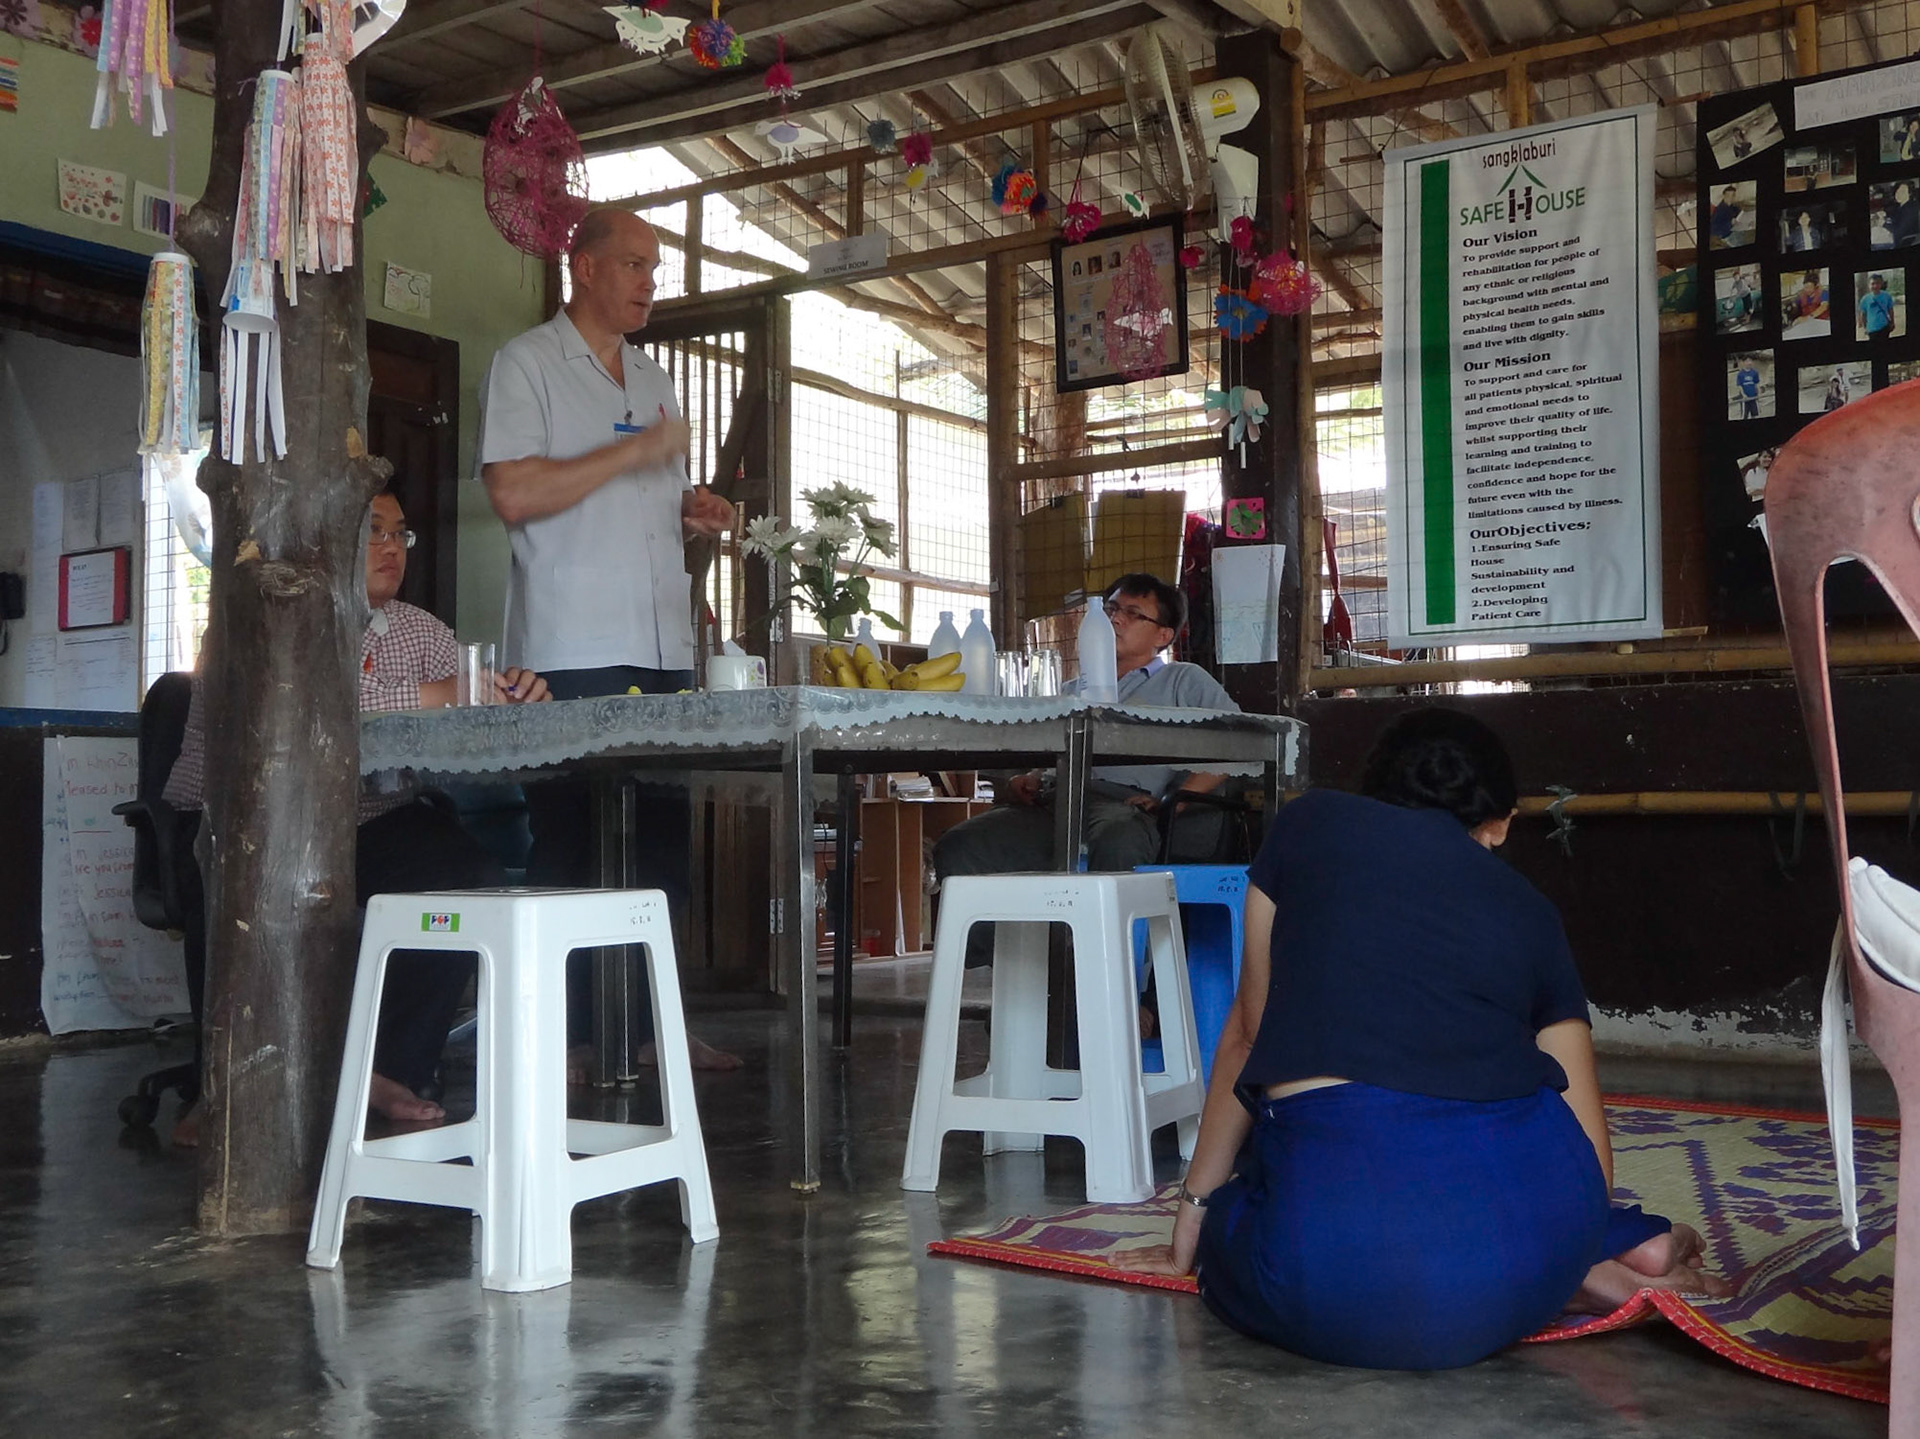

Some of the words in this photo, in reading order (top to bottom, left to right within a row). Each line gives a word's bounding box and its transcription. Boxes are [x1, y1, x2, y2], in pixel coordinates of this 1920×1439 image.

[1483, 138, 1556, 169] sangklaburi
[1460, 201, 1504, 225] SAFE
[1463, 237, 1489, 248] Our
[1494, 228, 1538, 243] Vision
[1479, 249, 1516, 262] provide
[1519, 241, 1559, 255] support
[1563, 236, 1580, 246] and
[847, 260, 869, 271] ROOM
[1463, 261, 1531, 277] rehabilitation
[1535, 257, 1549, 267] for
[1552, 250, 1585, 265] people
[1463, 284, 1480, 293] any
[1484, 279, 1515, 289] ethnic
[1532, 268, 1575, 282] religious
[1463, 290, 1524, 307] background
[1527, 287, 1548, 297] with
[1552, 282, 1586, 293] mental
[1590, 277, 1609, 286] and
[1463, 308, 1504, 322] physical
[1508, 303, 1539, 315] health
[1463, 323, 1506, 336] enabling
[1510, 320, 1535, 330] them
[1552, 313, 1574, 324] gain
[1577, 308, 1604, 319] skills
[1463, 342, 1481, 350] and
[1485, 338, 1502, 347] live
[1506, 335, 1526, 345] with
[1530, 330, 1569, 344] dignity.
[1464, 361, 1490, 372] Our
[1495, 351, 1550, 368] Mission
[1479, 373, 1520, 386] support
[1523, 370, 1543, 378] and
[1546, 367, 1569, 375] care
[1572, 363, 1587, 371] for
[1480, 386, 1522, 400] patients
[1576, 374, 1622, 387] spiritual
[1465, 407, 1483, 415] and
[1486, 400, 1539, 413] emotional
[1542, 395, 1574, 406] needs
[1466, 418, 1506, 431] improve
[1510, 415, 1534, 425] their
[1538, 410, 1575, 423] quality
[1579, 408, 1590, 416] of
[1466, 435, 1495, 445] whilst
[1499, 428, 1557, 443] supporting
[1561, 424, 1587, 434] their
[1466, 449, 1507, 460] learning
[1511, 445, 1530, 454] and
[1534, 441, 1577, 452] training
[1581, 439, 1591, 447] to
[1467, 463, 1511, 474] facilitate
[1467, 477, 1523, 490] confidence
[1527, 473, 1545, 482] and
[1549, 470, 1577, 481] hope
[1580, 468, 1595, 477] for
[1599, 466, 1616, 475] the
[1468, 494, 1497, 504] future
[1501, 491, 1525, 501] even
[1529, 488, 1552, 498] with
[1556, 487, 1573, 495] the
[1468, 505, 1523, 519] limitations
[1527, 502, 1565, 513] caused
[1568, 501, 1582, 510] by
[1585, 497, 1622, 508] illness.
[1471, 541, 1532, 553] 1.Ensuring
[1535, 538, 1560, 547] Safe
[1471, 557, 1504, 566] House
[1471, 566, 1549, 580] Sustainability
[1553, 565, 1575, 574] and
[1471, 581, 1546, 594] development
[1472, 595, 1548, 607] 2.Developing
[1472, 611, 1512, 621] Patient
